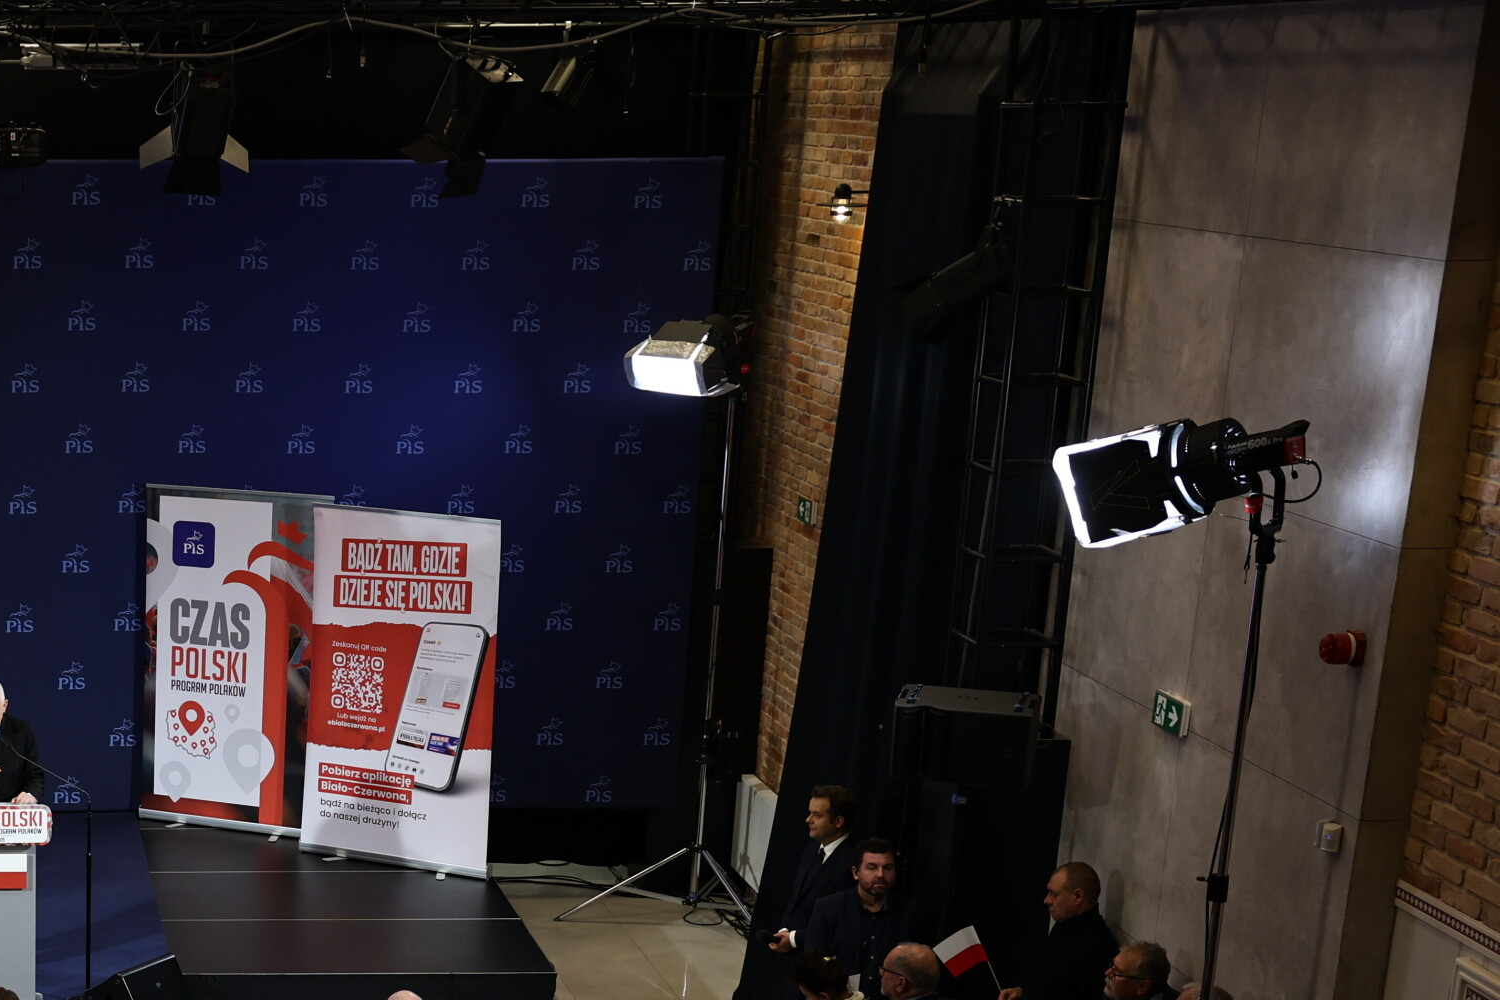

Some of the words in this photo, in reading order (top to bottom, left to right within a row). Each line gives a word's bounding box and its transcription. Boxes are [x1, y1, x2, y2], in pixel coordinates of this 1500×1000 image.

[72, 190, 100, 205] PiS
[299, 191, 327, 206] PiS
[411, 193, 438, 207] PiS
[522, 192, 549, 207] PiS
[634, 194, 661, 208] PiS
[13, 254, 41, 269] PiS
[125, 253, 153, 268] PiS
[240, 254, 268, 269] PiS
[351, 255, 379, 270] PiS
[462, 255, 489, 270] PiS
[572, 254, 599, 270] PiS
[683, 255, 711, 271] PiS
[68, 315, 95, 330] PiS
[183, 316, 210, 331] PiS
[293, 316, 320, 331] PiS
[403, 317, 430, 332] PiS
[512, 316, 540, 332] PiS
[623, 318, 650, 333] PiS
[12, 378, 39, 393] PiS
[122, 377, 149, 392] PiS
[235, 378, 263, 392] PiS
[345, 378, 372, 393] PiS
[454, 378, 482, 393] PiS
[564, 378, 590, 393] PiS
[65, 438, 93, 453] PiS
[179, 438, 205, 453] PiS
[287, 439, 314, 453] PiS
[396, 439, 424, 454] PiS
[505, 438, 532, 453] PiS
[614, 439, 641, 454] PiS
[9, 499, 36, 514] PiS
[118, 499, 146, 513] PiS
[446, 500, 475, 514] PiS
[555, 499, 581, 513] PiS
[663, 499, 690, 513] PiS
[183, 541, 205, 556] PiS
[347, 538, 382, 576] BĄDŹ
[385, 543, 417, 576] TAM,
[420, 545, 460, 575] GDZIE
[62, 558, 89, 573] PiS
[606, 558, 632, 573] PiS
[339, 577, 384, 608] DZIEJE
[385, 579, 406, 614] SIĘ
[408, 580, 466, 612] POLSKA!
[6, 618, 33, 632] PiS
[114, 617, 141, 631] PiS
[169, 597, 251, 650] CZAS
[546, 616, 572, 630] PiS
[654, 616, 680, 631] PiS
[332, 641, 360, 652] Zeskanuj
[360, 643, 370, 651] QR
[370, 645, 387, 653] code
[170, 646, 248, 684] POLSKI
[58, 675, 85, 689] PiS
[170, 680, 208, 696] PROGRAM
[208, 680, 247, 698] POLAKÓW
[596, 675, 622, 688] PiS
[349, 713, 367, 722] wejdź
[109, 731, 136, 746] PiS
[536, 731, 563, 745] PiS
[643, 732, 669, 745] PiS
[321, 765, 360, 779] Pobierz
[362, 771, 412, 789] aplikację
[54, 789, 81, 804] PiS
[321, 781, 410, 803] Biało-Czerwona,
[585, 788, 611, 802] PiS
[320, 797, 341, 808] bądź
[343, 802, 355, 810] na
[357, 803, 391, 815] bieżąco
[397, 809, 427, 822] dołącz
[319, 810, 331, 818] do
[333, 812, 361, 825] naszej
[362, 816, 400, 830] drużyny!
